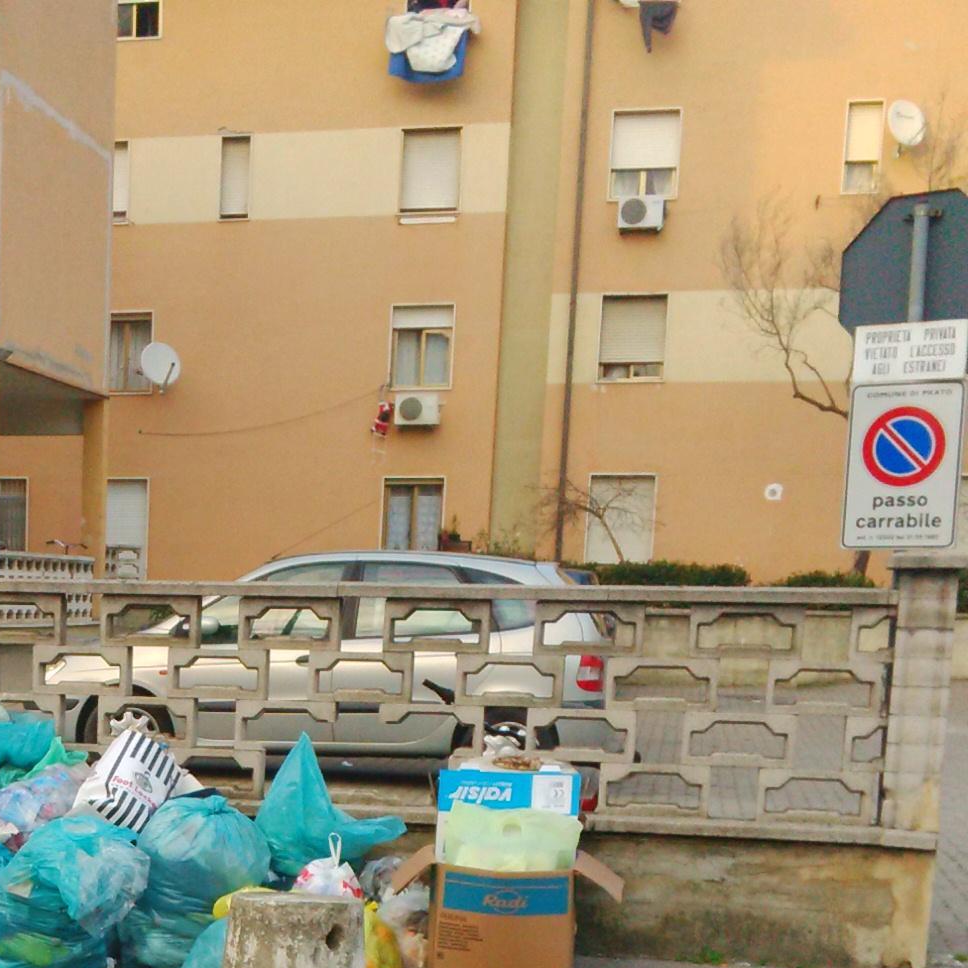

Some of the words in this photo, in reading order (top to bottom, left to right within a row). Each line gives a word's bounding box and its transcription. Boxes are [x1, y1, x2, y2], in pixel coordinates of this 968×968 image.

[923, 326, 956, 341] PRIVATA
[865, 346, 898, 360] VIETATO
[872, 362, 891, 375] AGLI
[902, 359, 946, 374] ESTRANEI
[872, 495, 928, 510] passo
[855, 513, 942, 529] carrabile
[112, 775, 133, 788] Foot
